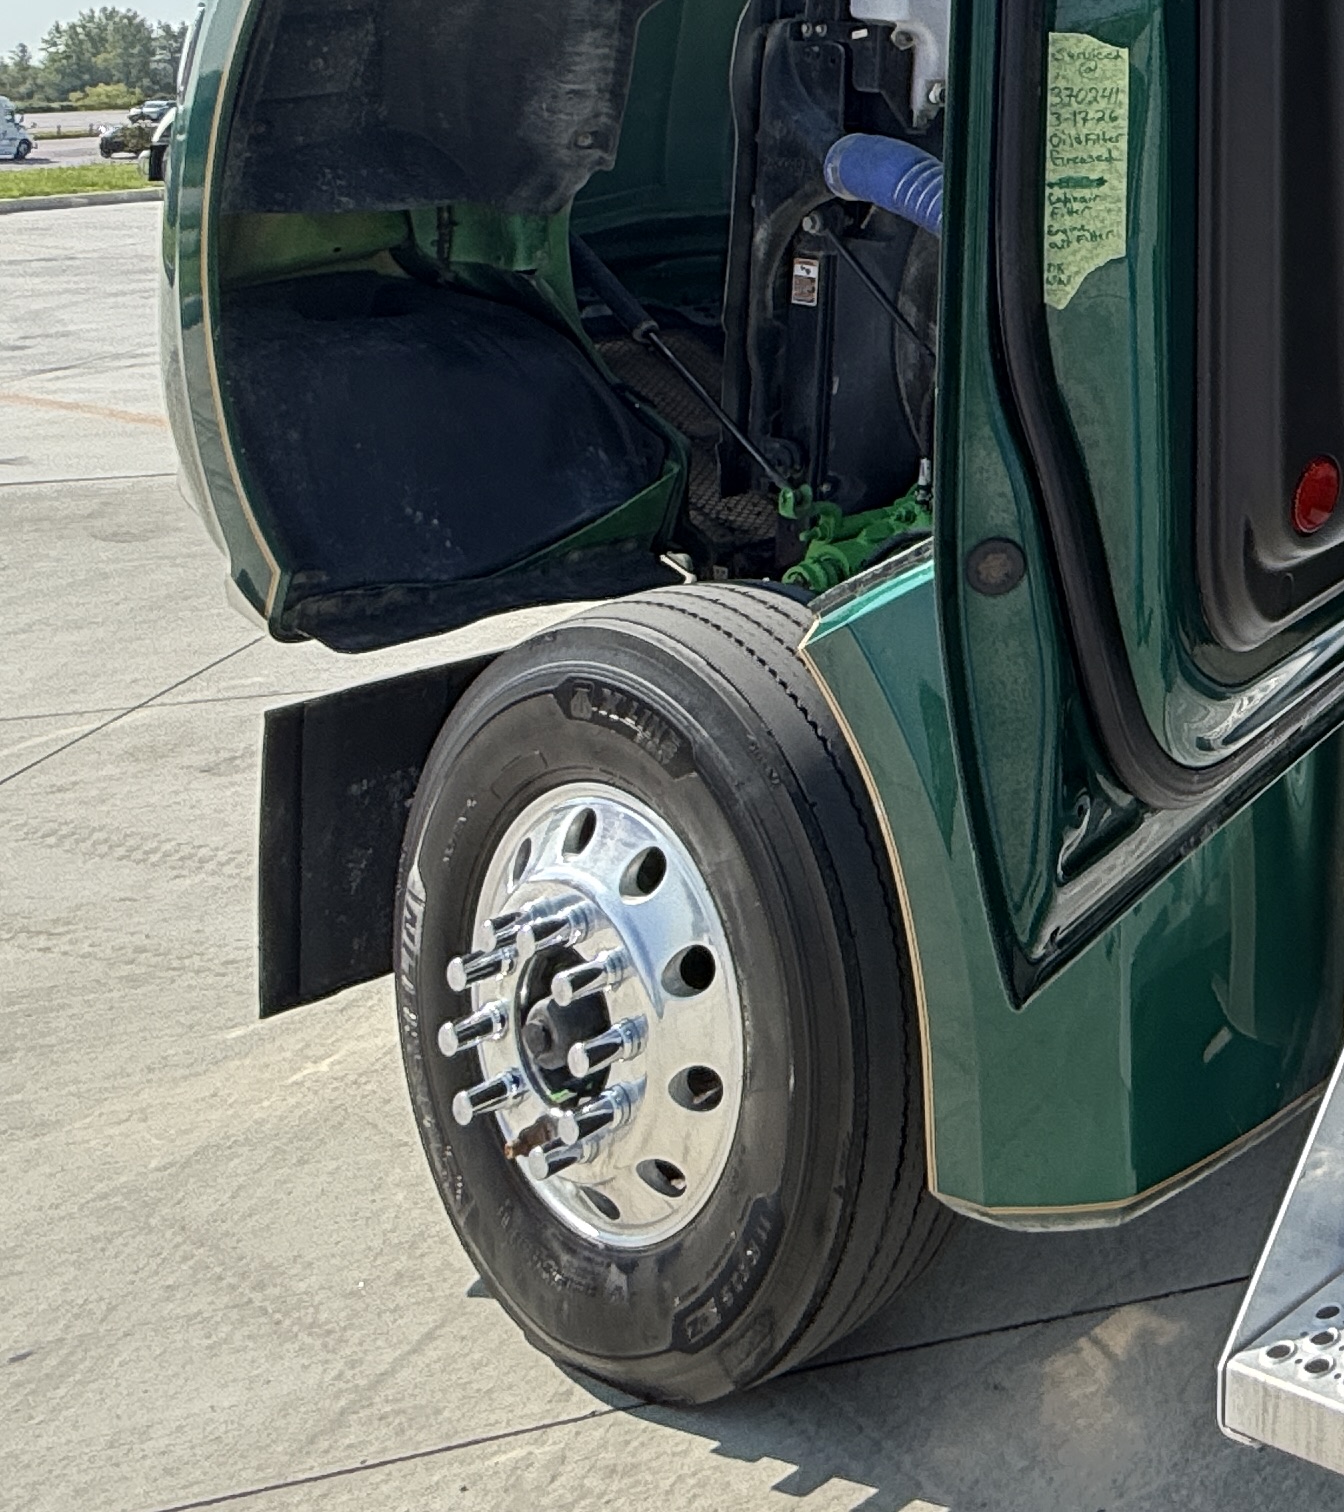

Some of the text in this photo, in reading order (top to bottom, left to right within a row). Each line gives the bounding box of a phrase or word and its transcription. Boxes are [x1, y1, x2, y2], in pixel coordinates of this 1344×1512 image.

[1051, 49, 1122, 61] Serviced
[1079, 60, 1100, 80] @
[1050, 87, 1119, 107] 370241
[1050, 148, 1124, 167] Greased
